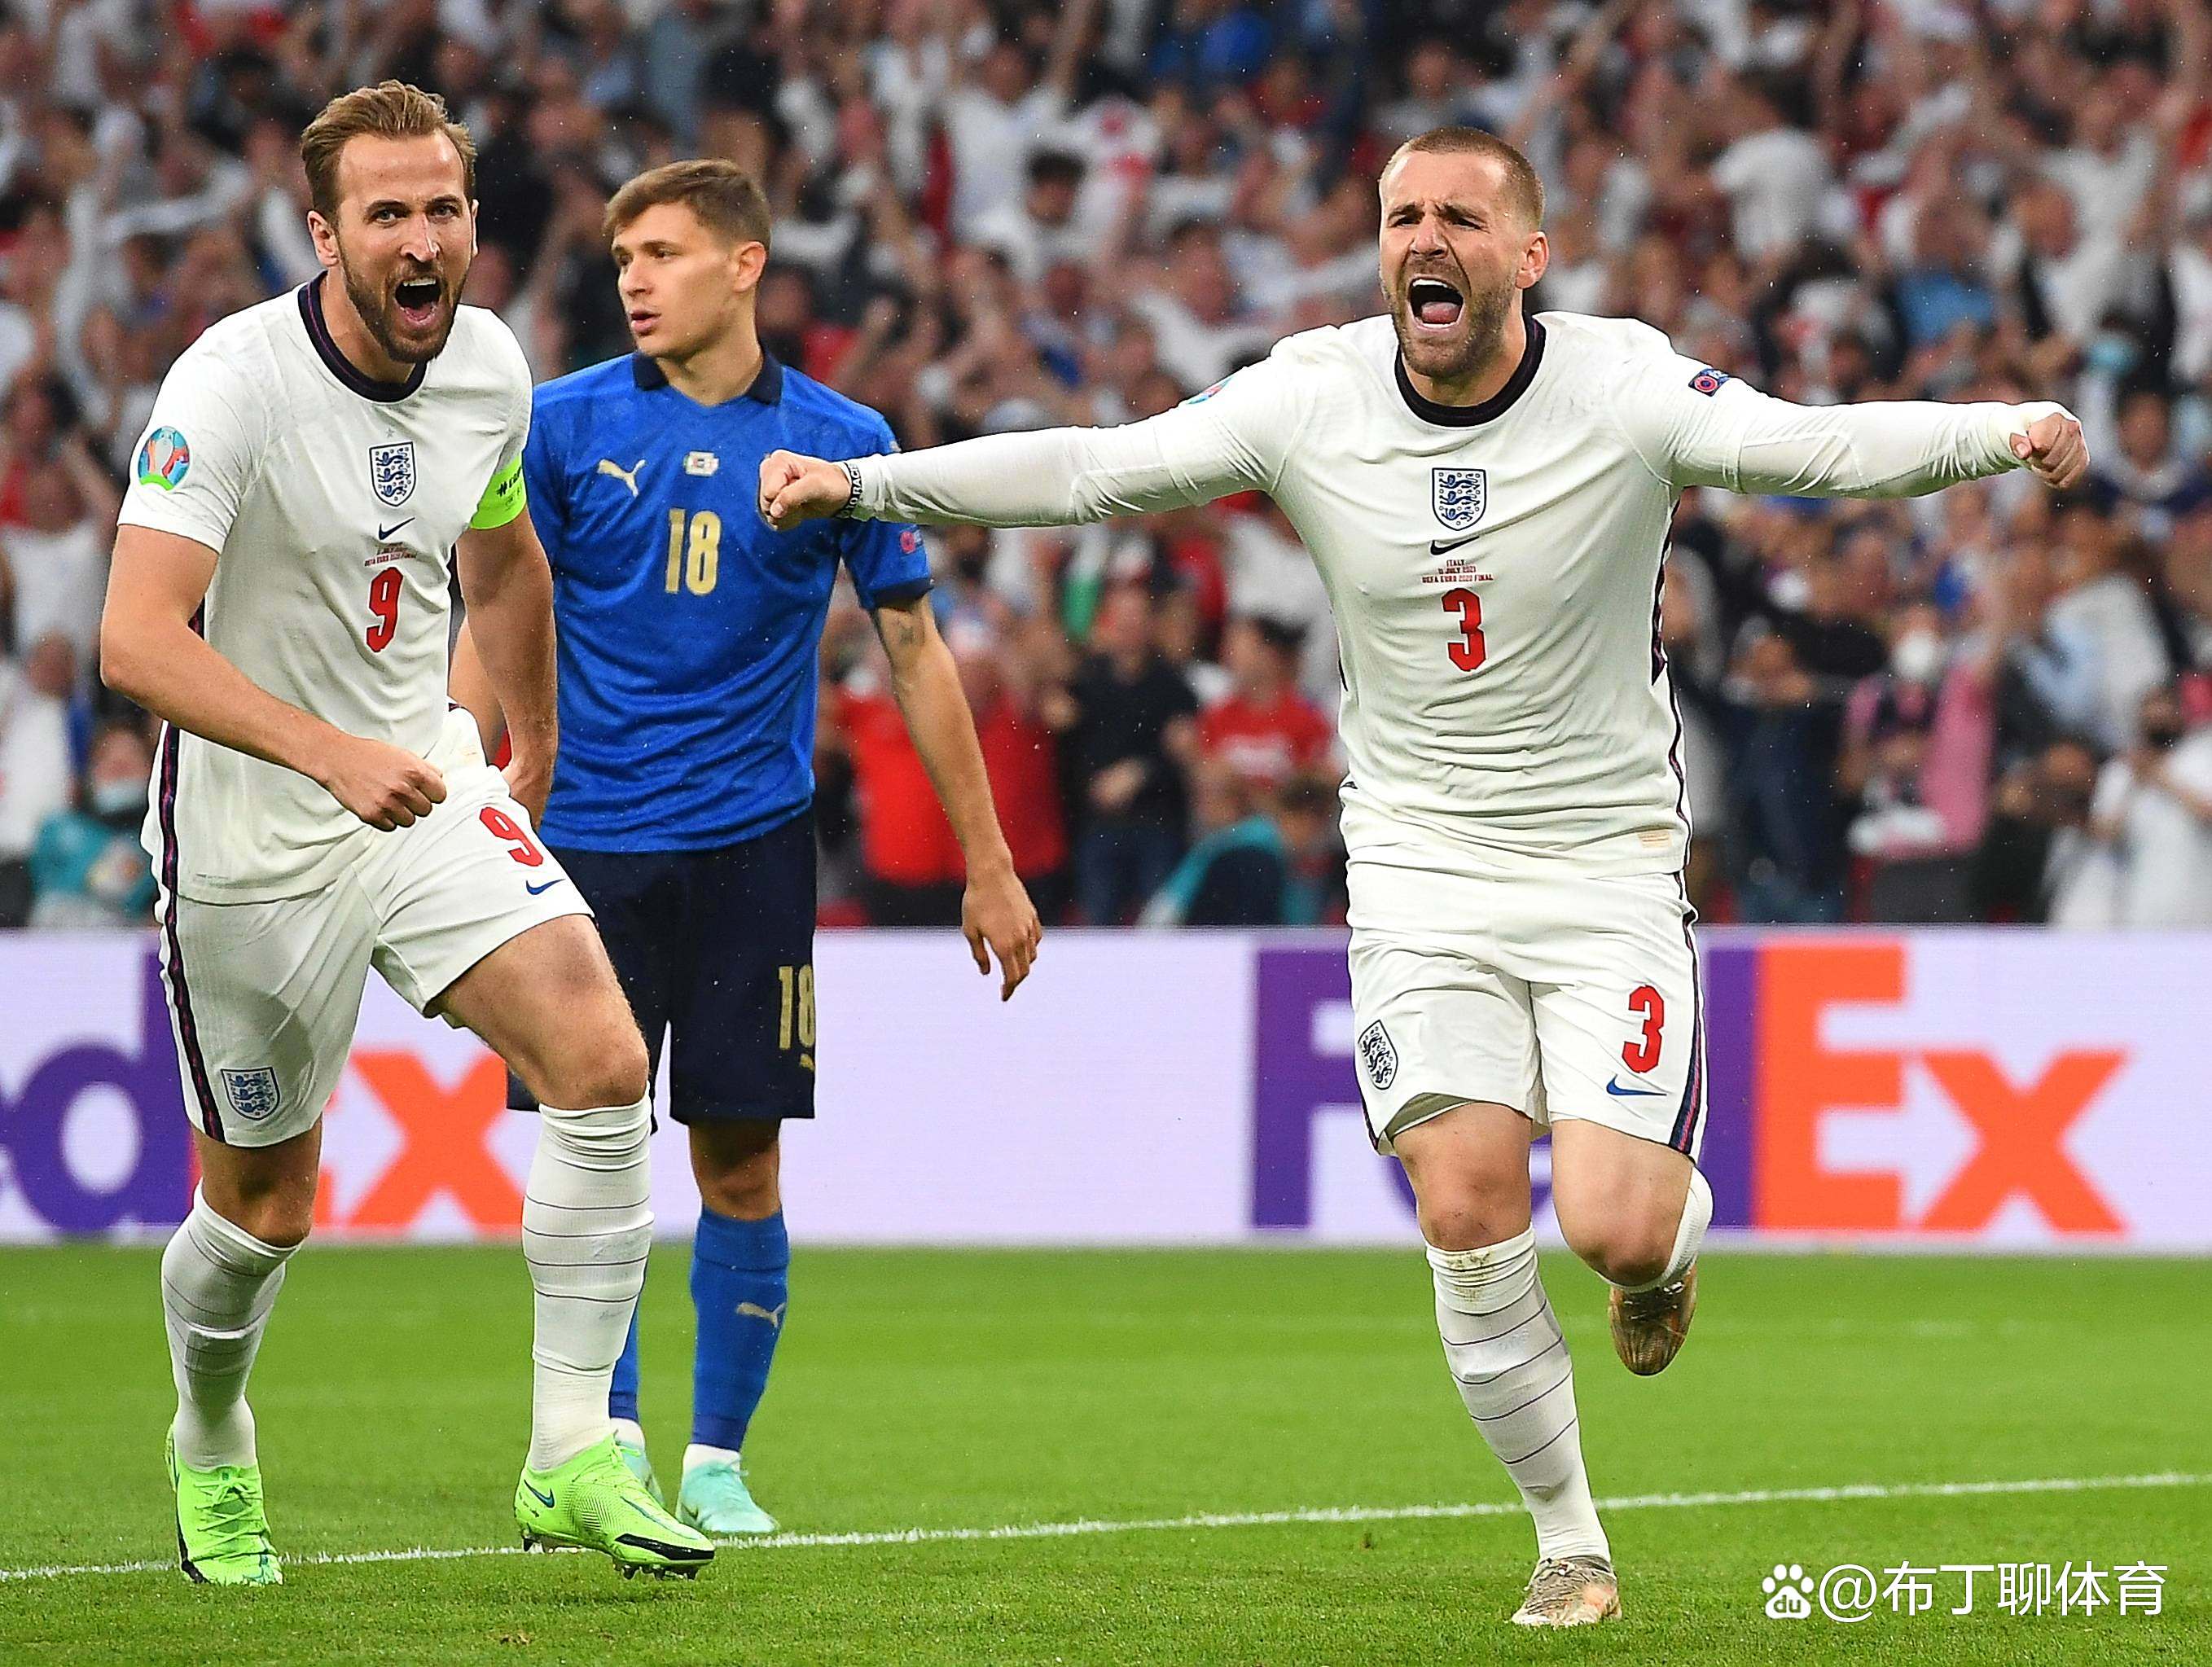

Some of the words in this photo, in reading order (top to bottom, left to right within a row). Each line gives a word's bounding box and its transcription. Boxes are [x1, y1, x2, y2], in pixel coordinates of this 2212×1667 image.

[665, 507, 722, 596] 18
[366, 567, 403, 652] 9
[1441, 587, 1486, 671] 3
[479, 806, 544, 867] 9
[779, 964, 815, 1050] 18
[1622, 984, 1665, 1074] 3
[1252, 941, 2131, 1235] FEx
